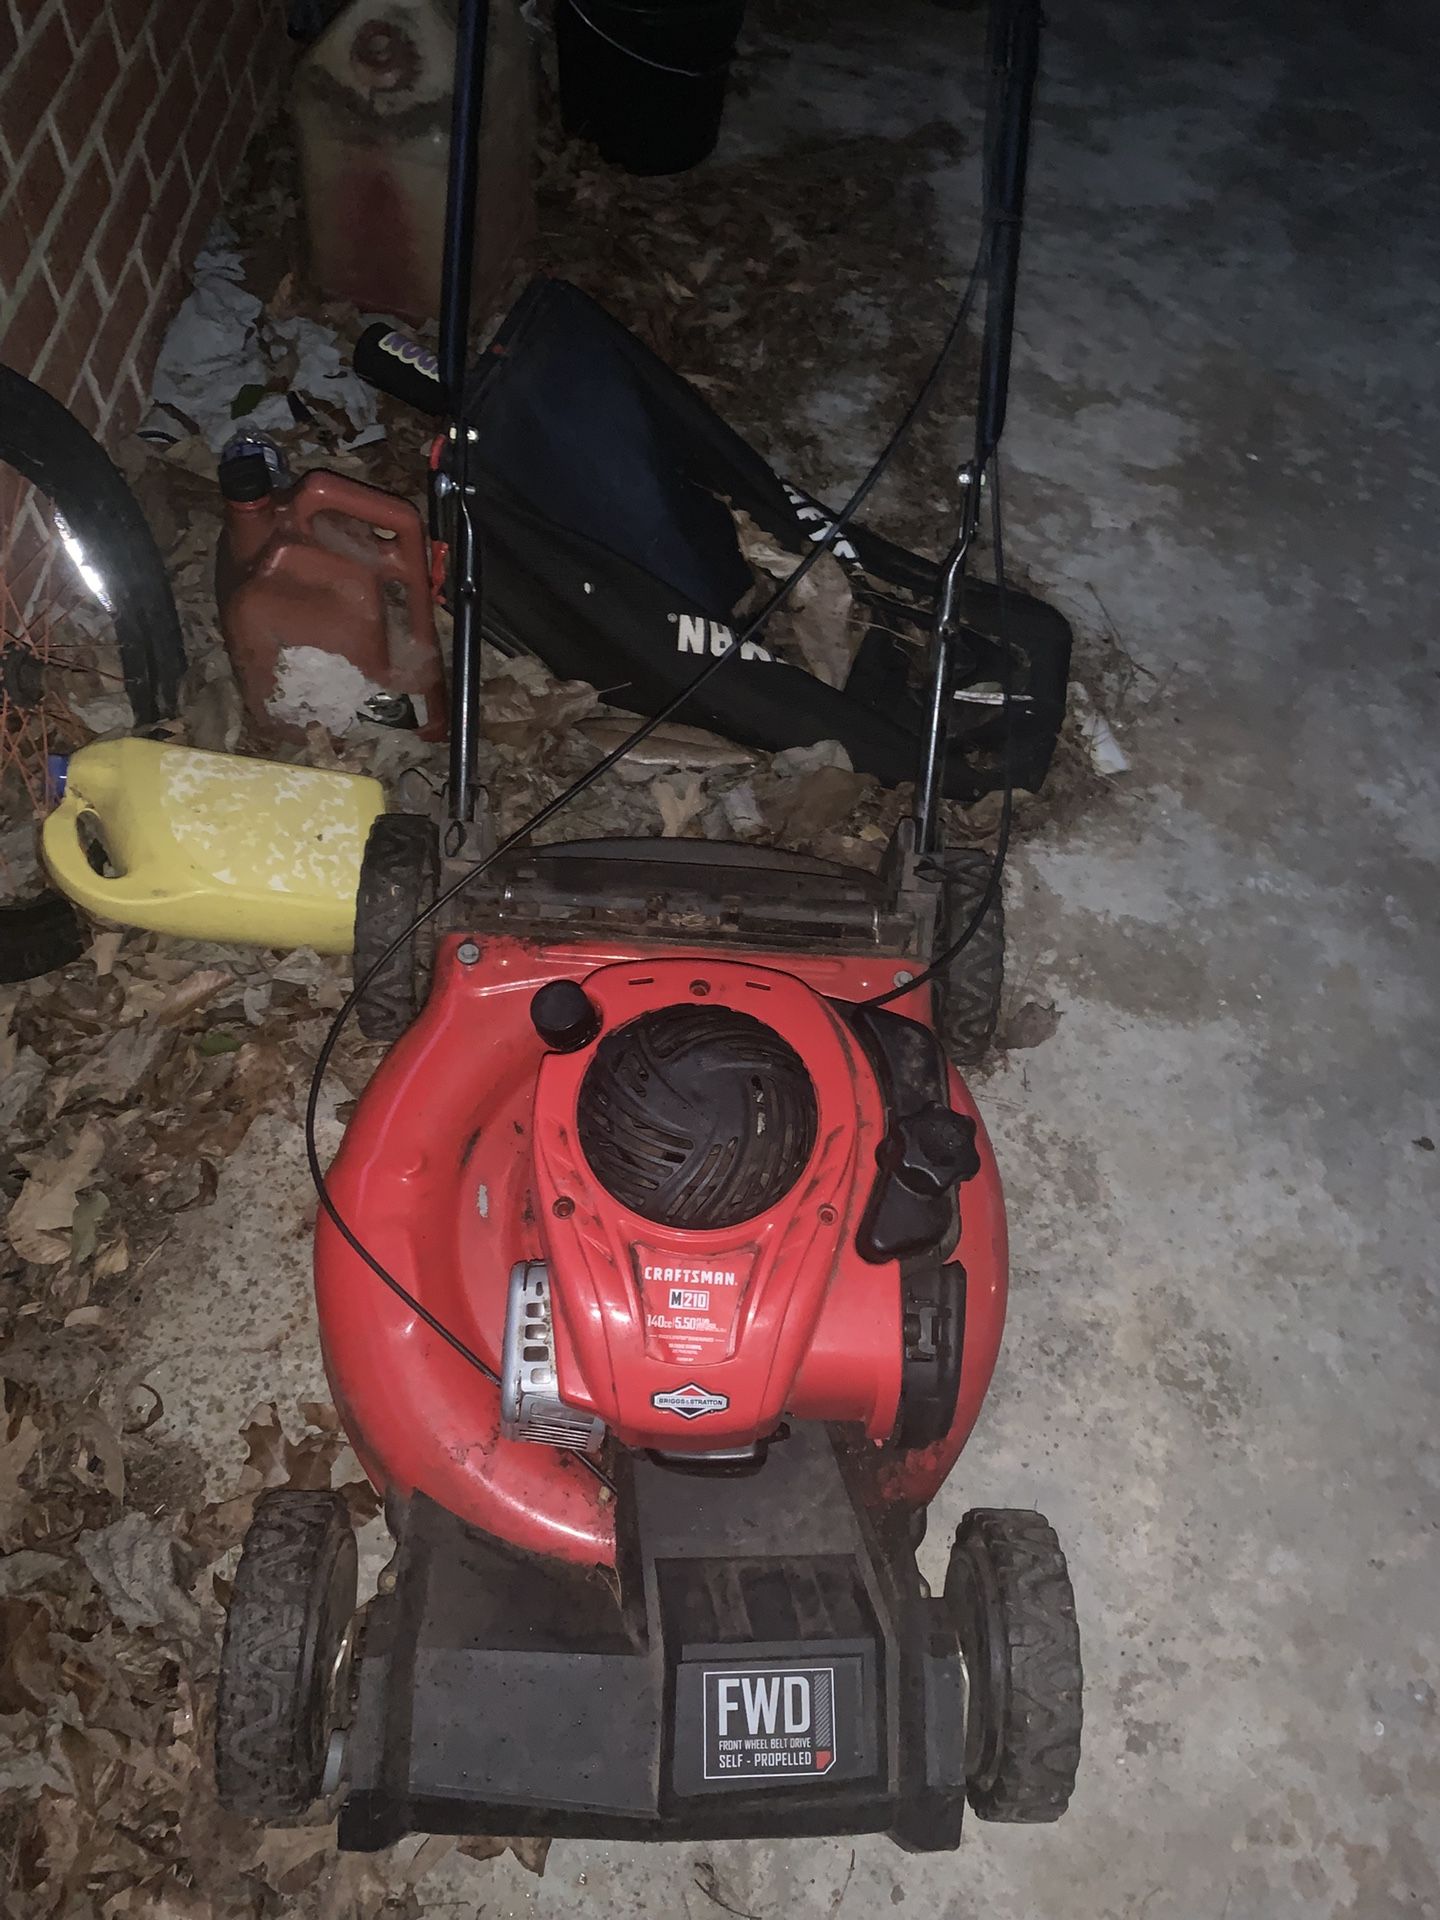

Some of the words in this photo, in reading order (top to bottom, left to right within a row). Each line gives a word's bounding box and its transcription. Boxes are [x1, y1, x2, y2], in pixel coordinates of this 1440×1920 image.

[644, 1266, 735, 1286] CRAFTSMAN
[671, 1291, 708, 1308] M210
[718, 1676, 811, 1736] FWD
[718, 1740, 743, 1751] FRONT
[744, 1739, 769, 1750] WHEEL
[770, 1738, 788, 1749] BELT
[789, 1737, 812, 1749] DRIVE
[719, 1754, 743, 1769] SELF
[754, 1751, 812, 1767] PROPELLED
